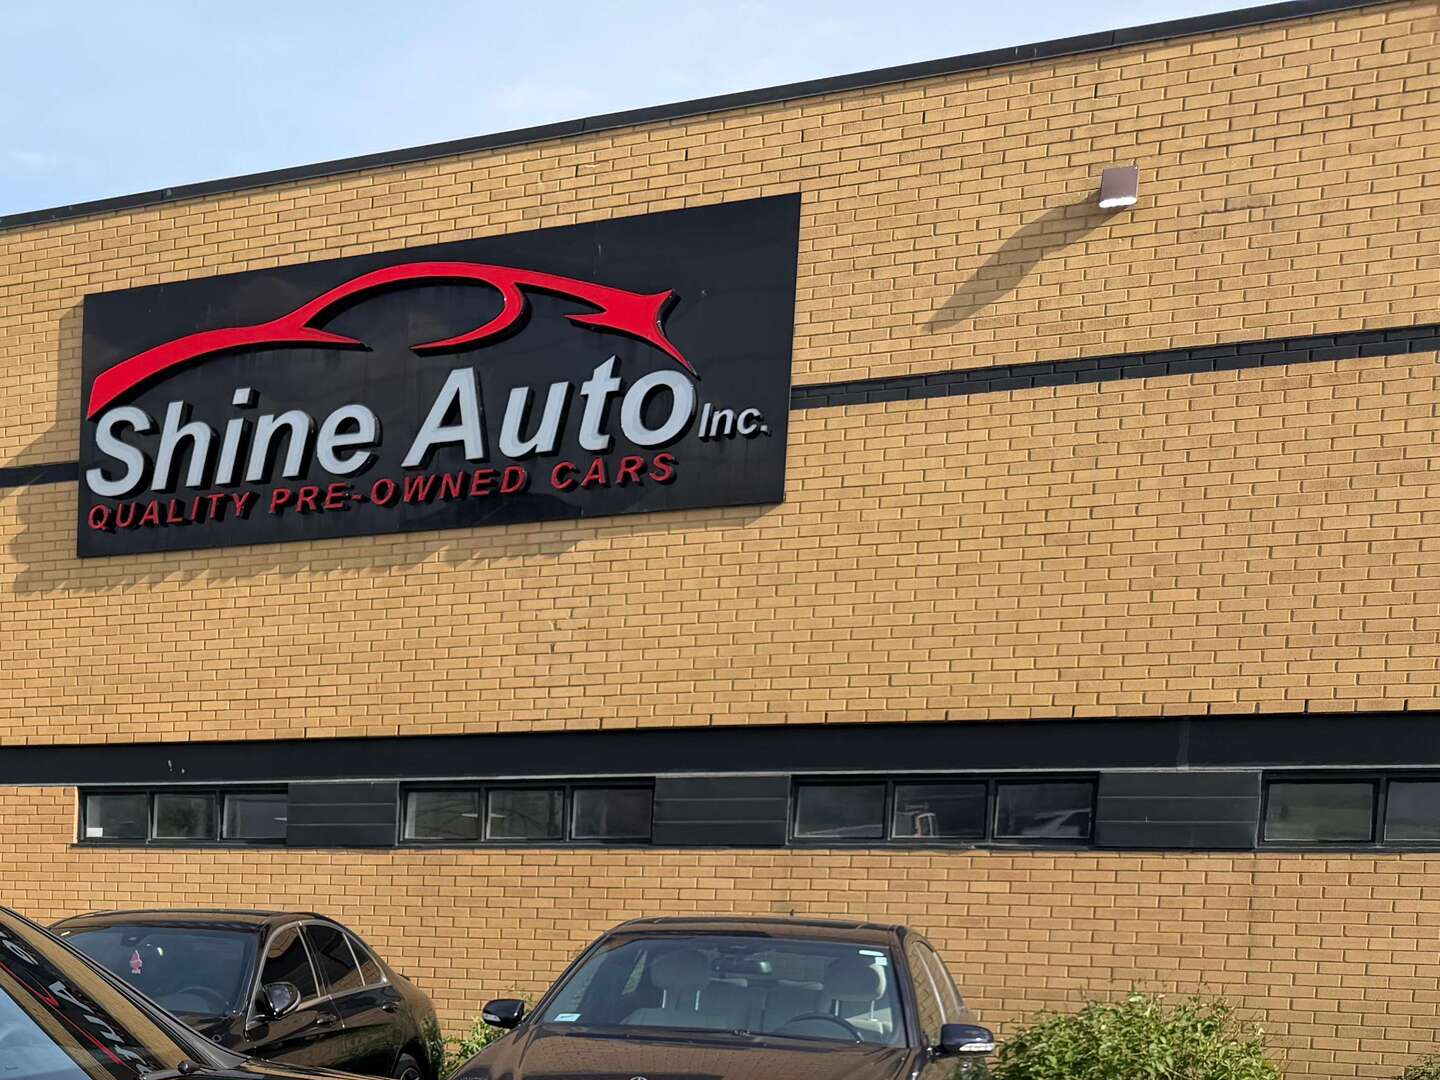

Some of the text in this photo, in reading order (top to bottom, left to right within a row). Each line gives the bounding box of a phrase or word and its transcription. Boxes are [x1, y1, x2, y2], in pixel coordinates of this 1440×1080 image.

[85, 355, 769, 497] Shine Auto Inc.
[87, 452, 677, 532] QUALITY PRE-OWNED CARS
